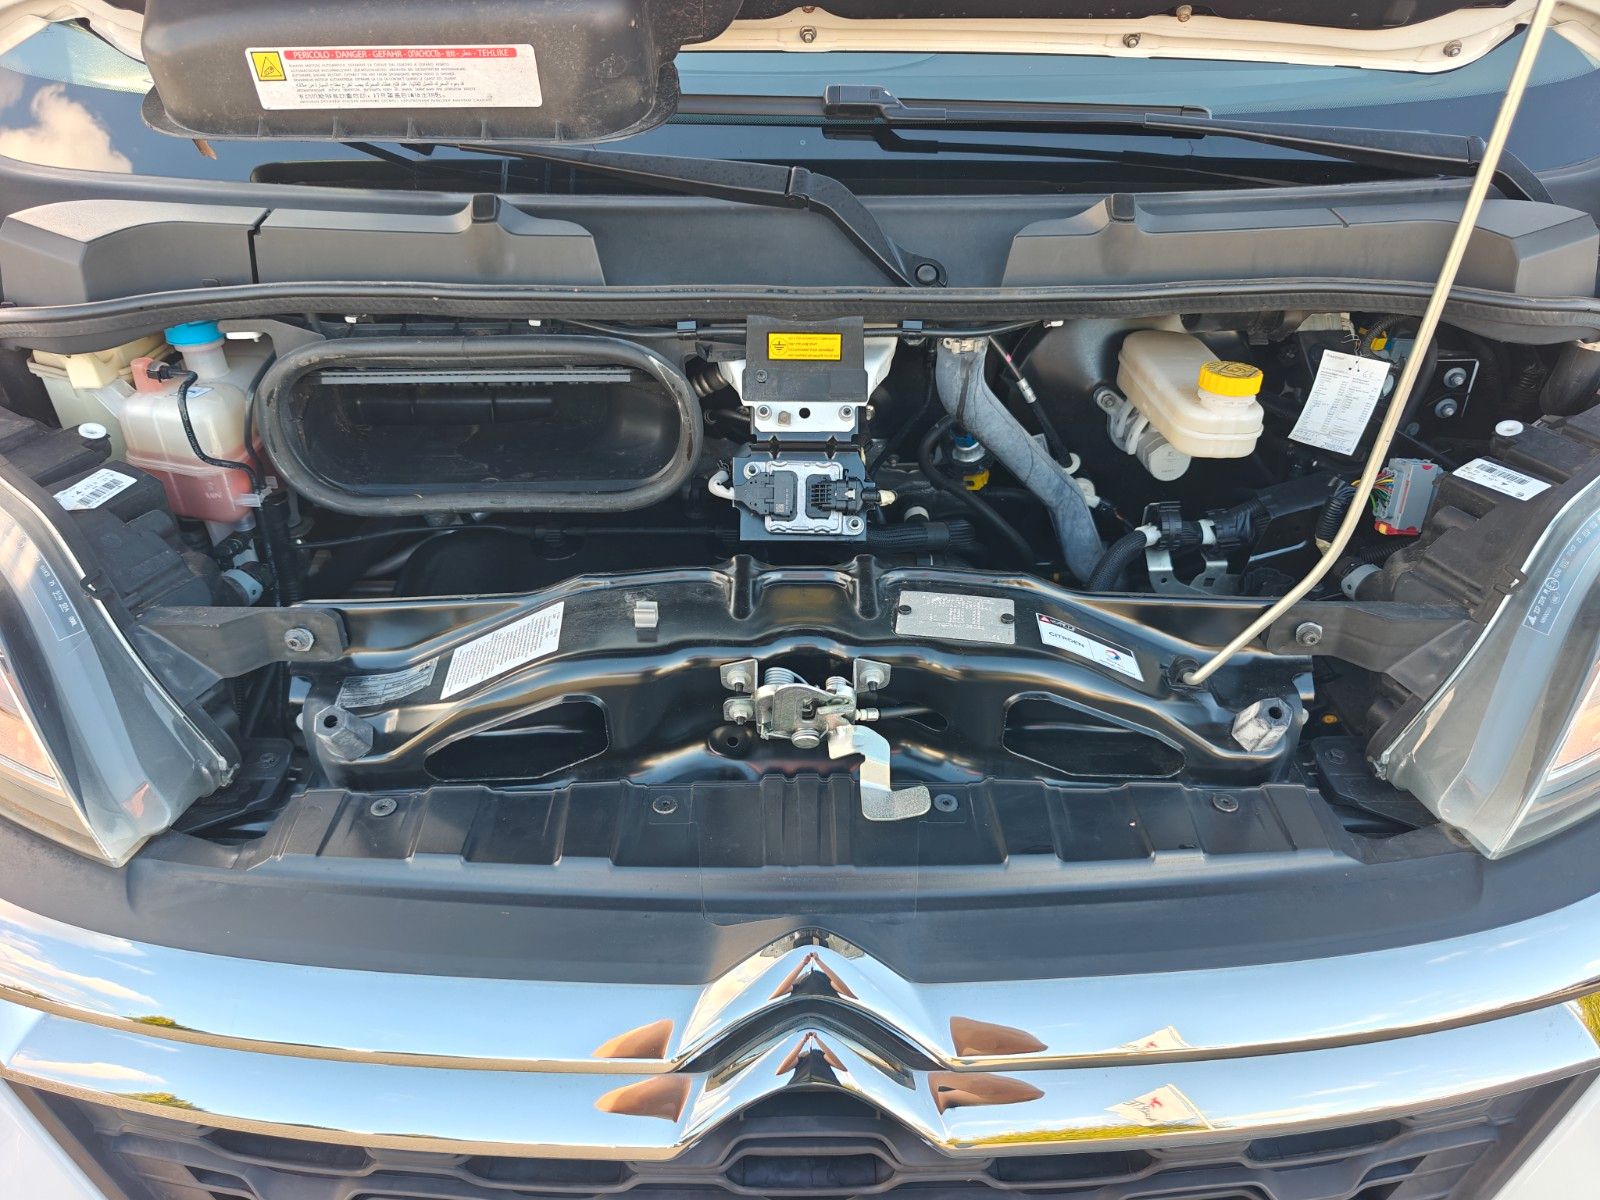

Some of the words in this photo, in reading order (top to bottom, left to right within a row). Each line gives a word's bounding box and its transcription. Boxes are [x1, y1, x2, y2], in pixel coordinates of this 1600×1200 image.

[293, 50, 330, 59] PERICOLO
[335, 50, 368, 59] DANGER
[372, 49, 402, 58] GEFAHR
